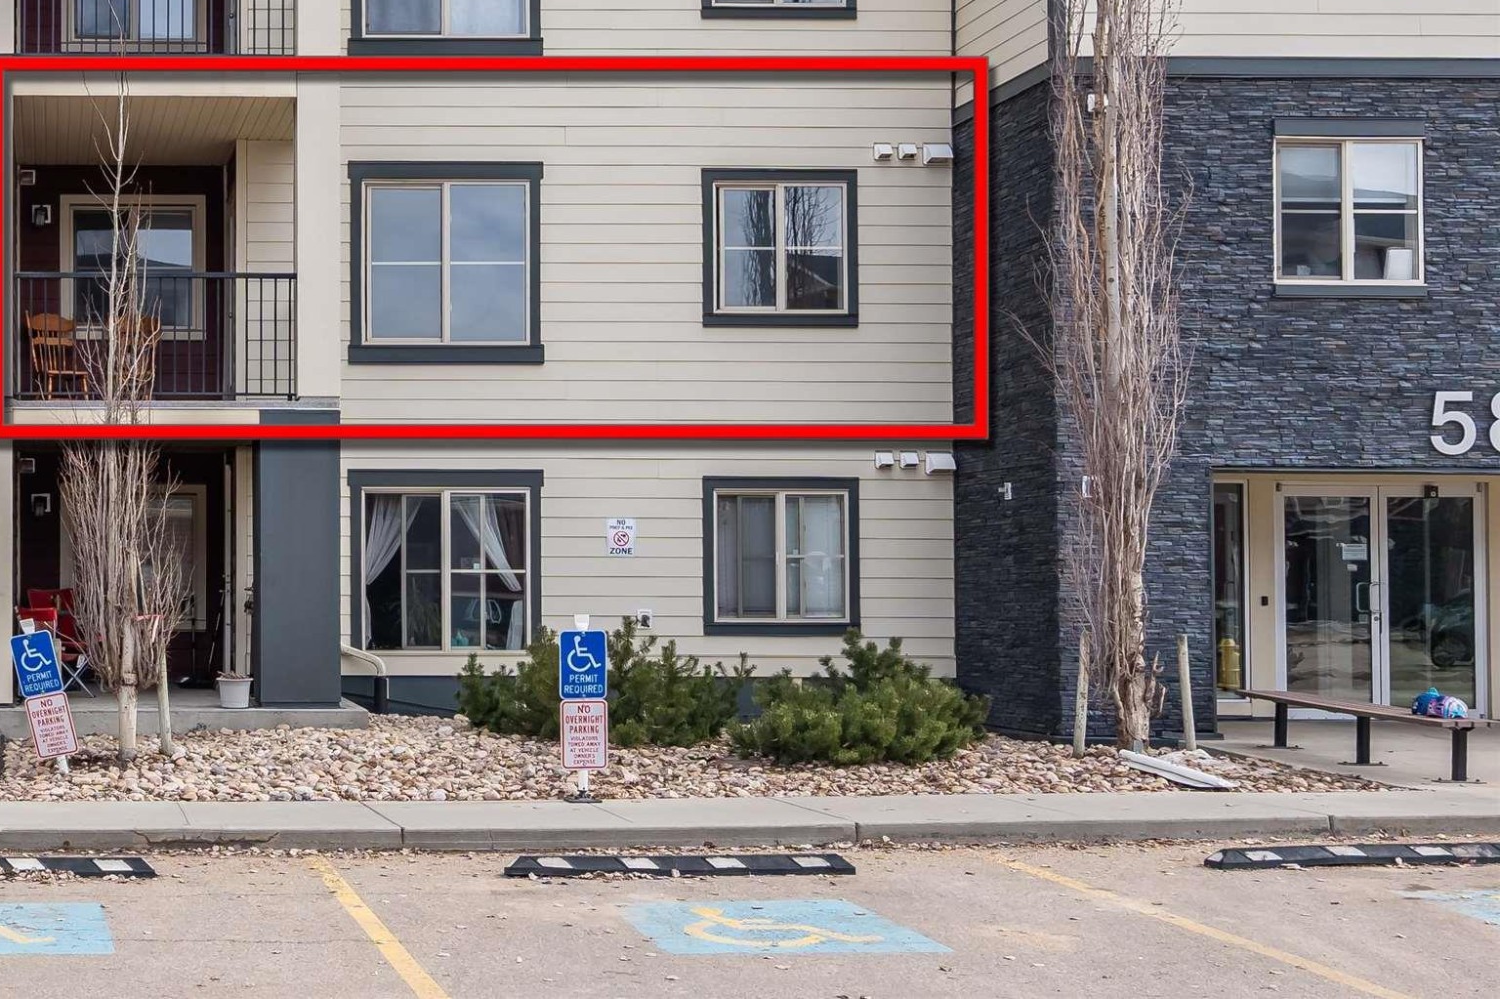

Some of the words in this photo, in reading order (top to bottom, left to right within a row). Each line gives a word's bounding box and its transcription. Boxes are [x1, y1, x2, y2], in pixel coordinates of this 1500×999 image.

[1430, 391, 1500, 455] 5
[609, 547, 633, 555] ZONE
[26, 671, 52, 683] PERMIT
[569, 674, 598, 683] PERMIT
[24, 679, 60, 692] REQUIRED
[563, 684, 603, 694] REQUIRED
[40, 699, 53, 708] NO
[31, 706, 66, 719] OVERNIGHT
[577, 704, 591, 714] NO
[38, 716, 65, 727] PARKING
[565, 715, 603, 724] OVERNIGHT
[569, 725, 599, 734] PARKING
